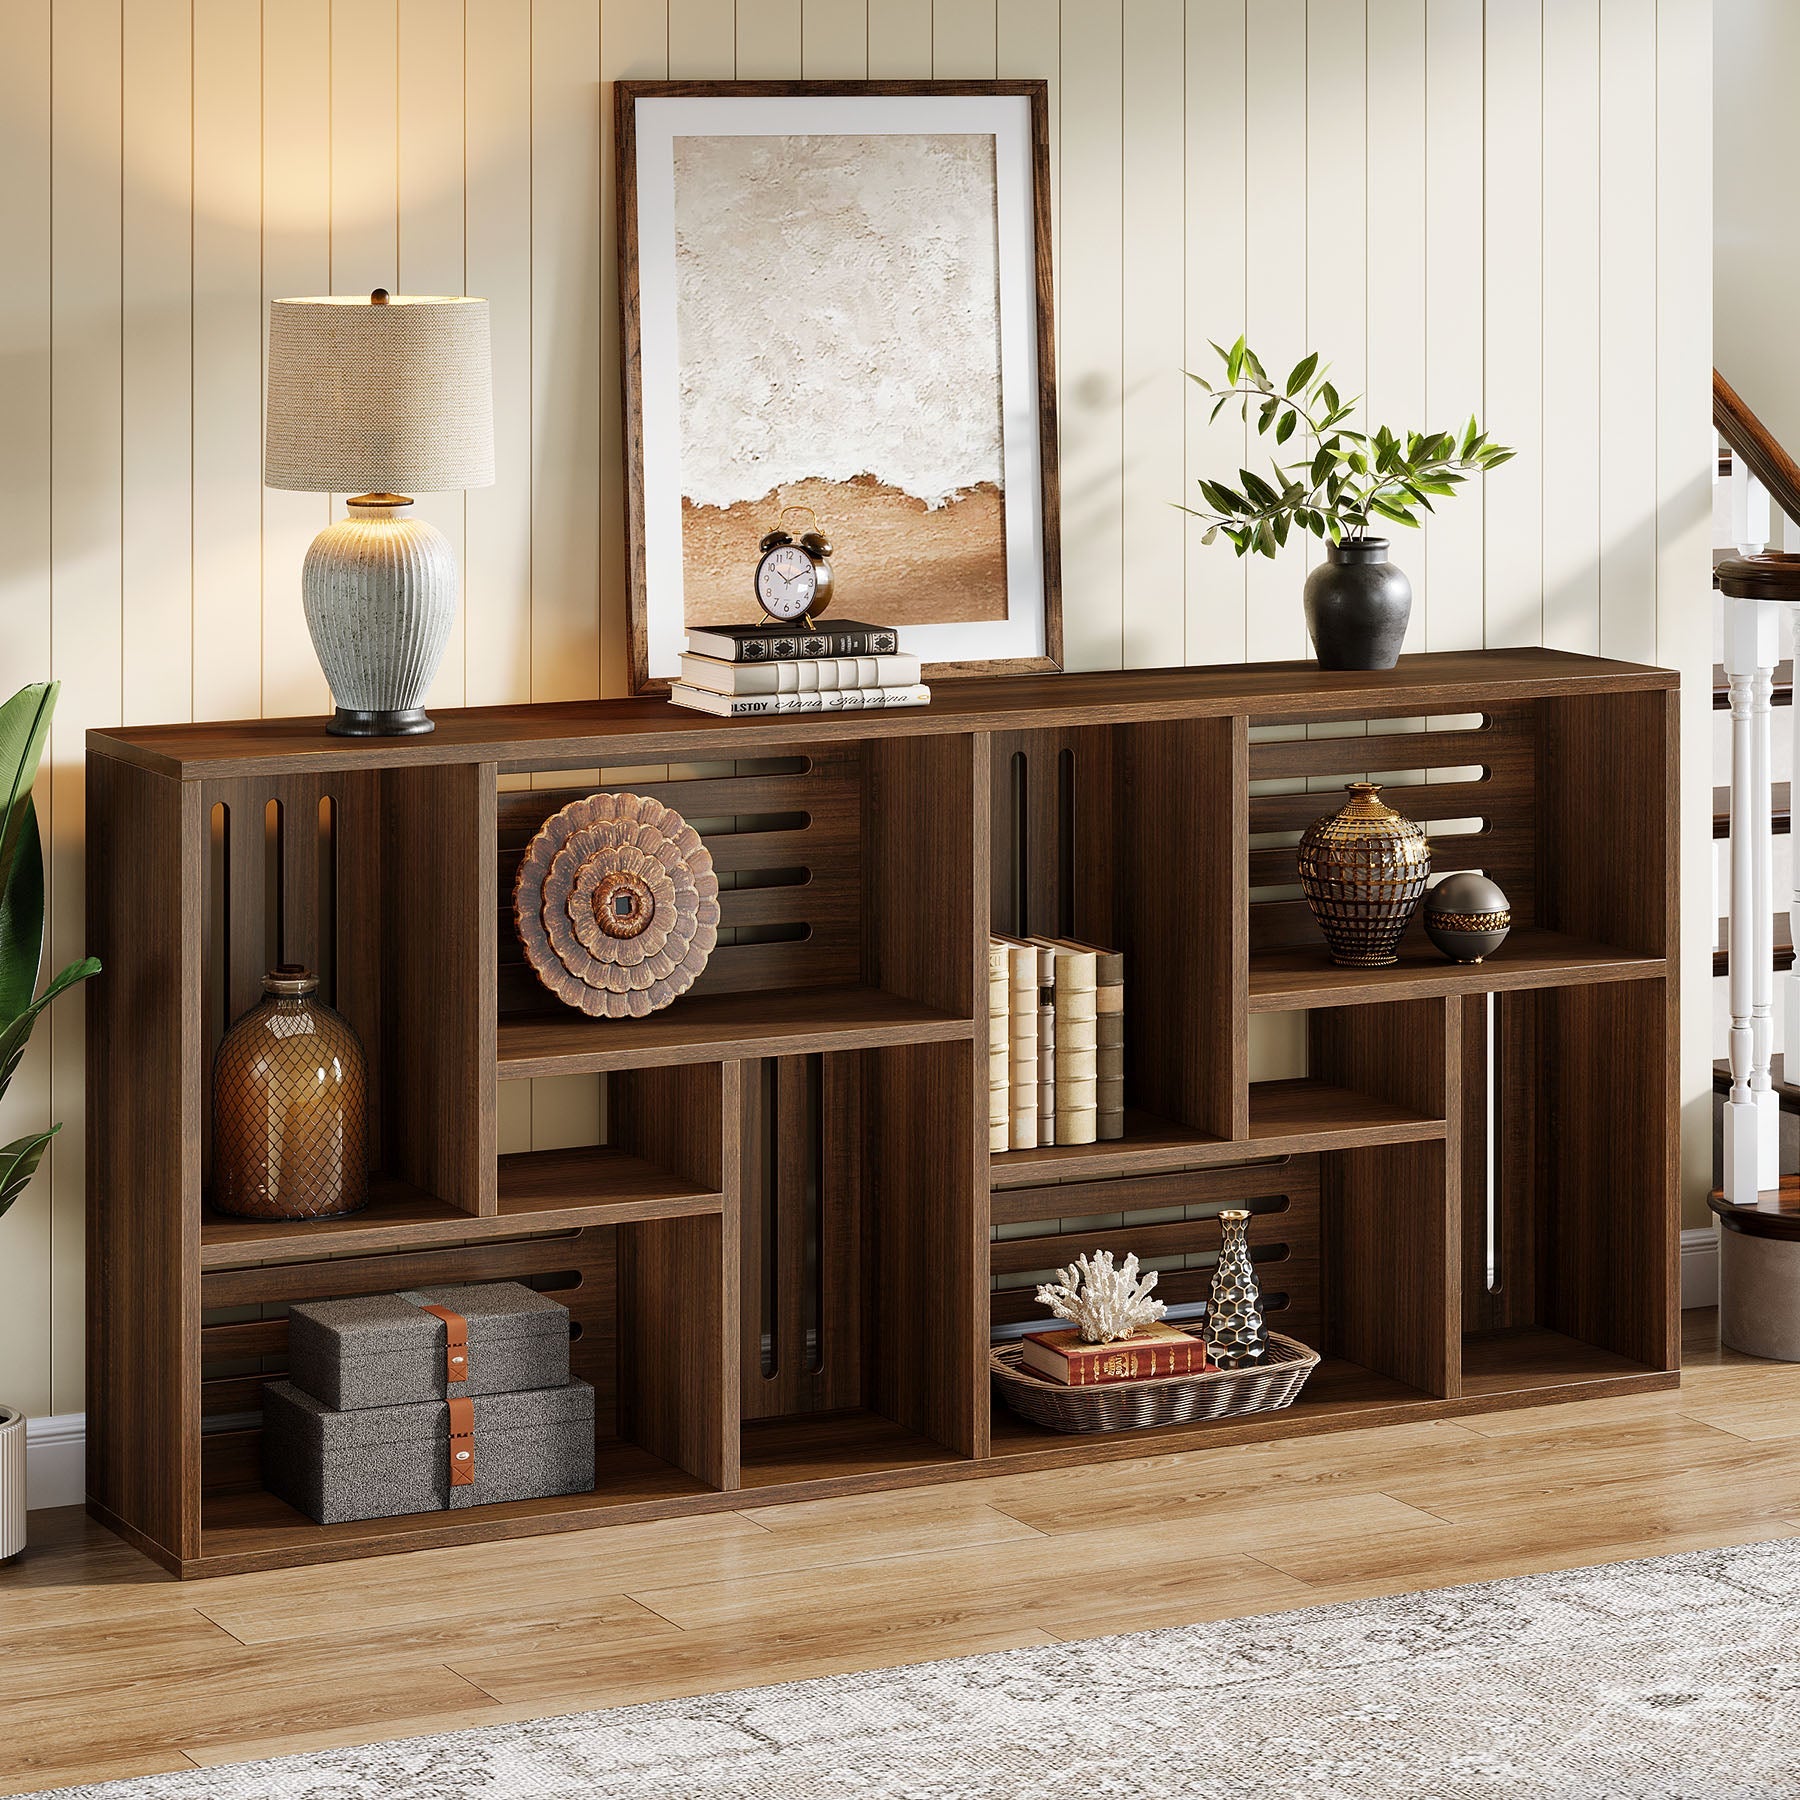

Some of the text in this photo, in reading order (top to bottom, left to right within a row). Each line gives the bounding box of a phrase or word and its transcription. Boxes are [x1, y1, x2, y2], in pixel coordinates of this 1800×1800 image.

[776, 554, 783, 563] 11
[785, 550, 794, 559] 12
[767, 563, 776, 571] 10
[805, 564, 812, 573] 2
[763, 575, 770, 583] 9
[808, 578, 814, 587] 3
[765, 588, 772, 597] 8
[803, 592, 810, 600] 4
[773, 597, 780, 607] 7
[794, 600, 801, 609] 5
[783, 603, 790, 612] 6
